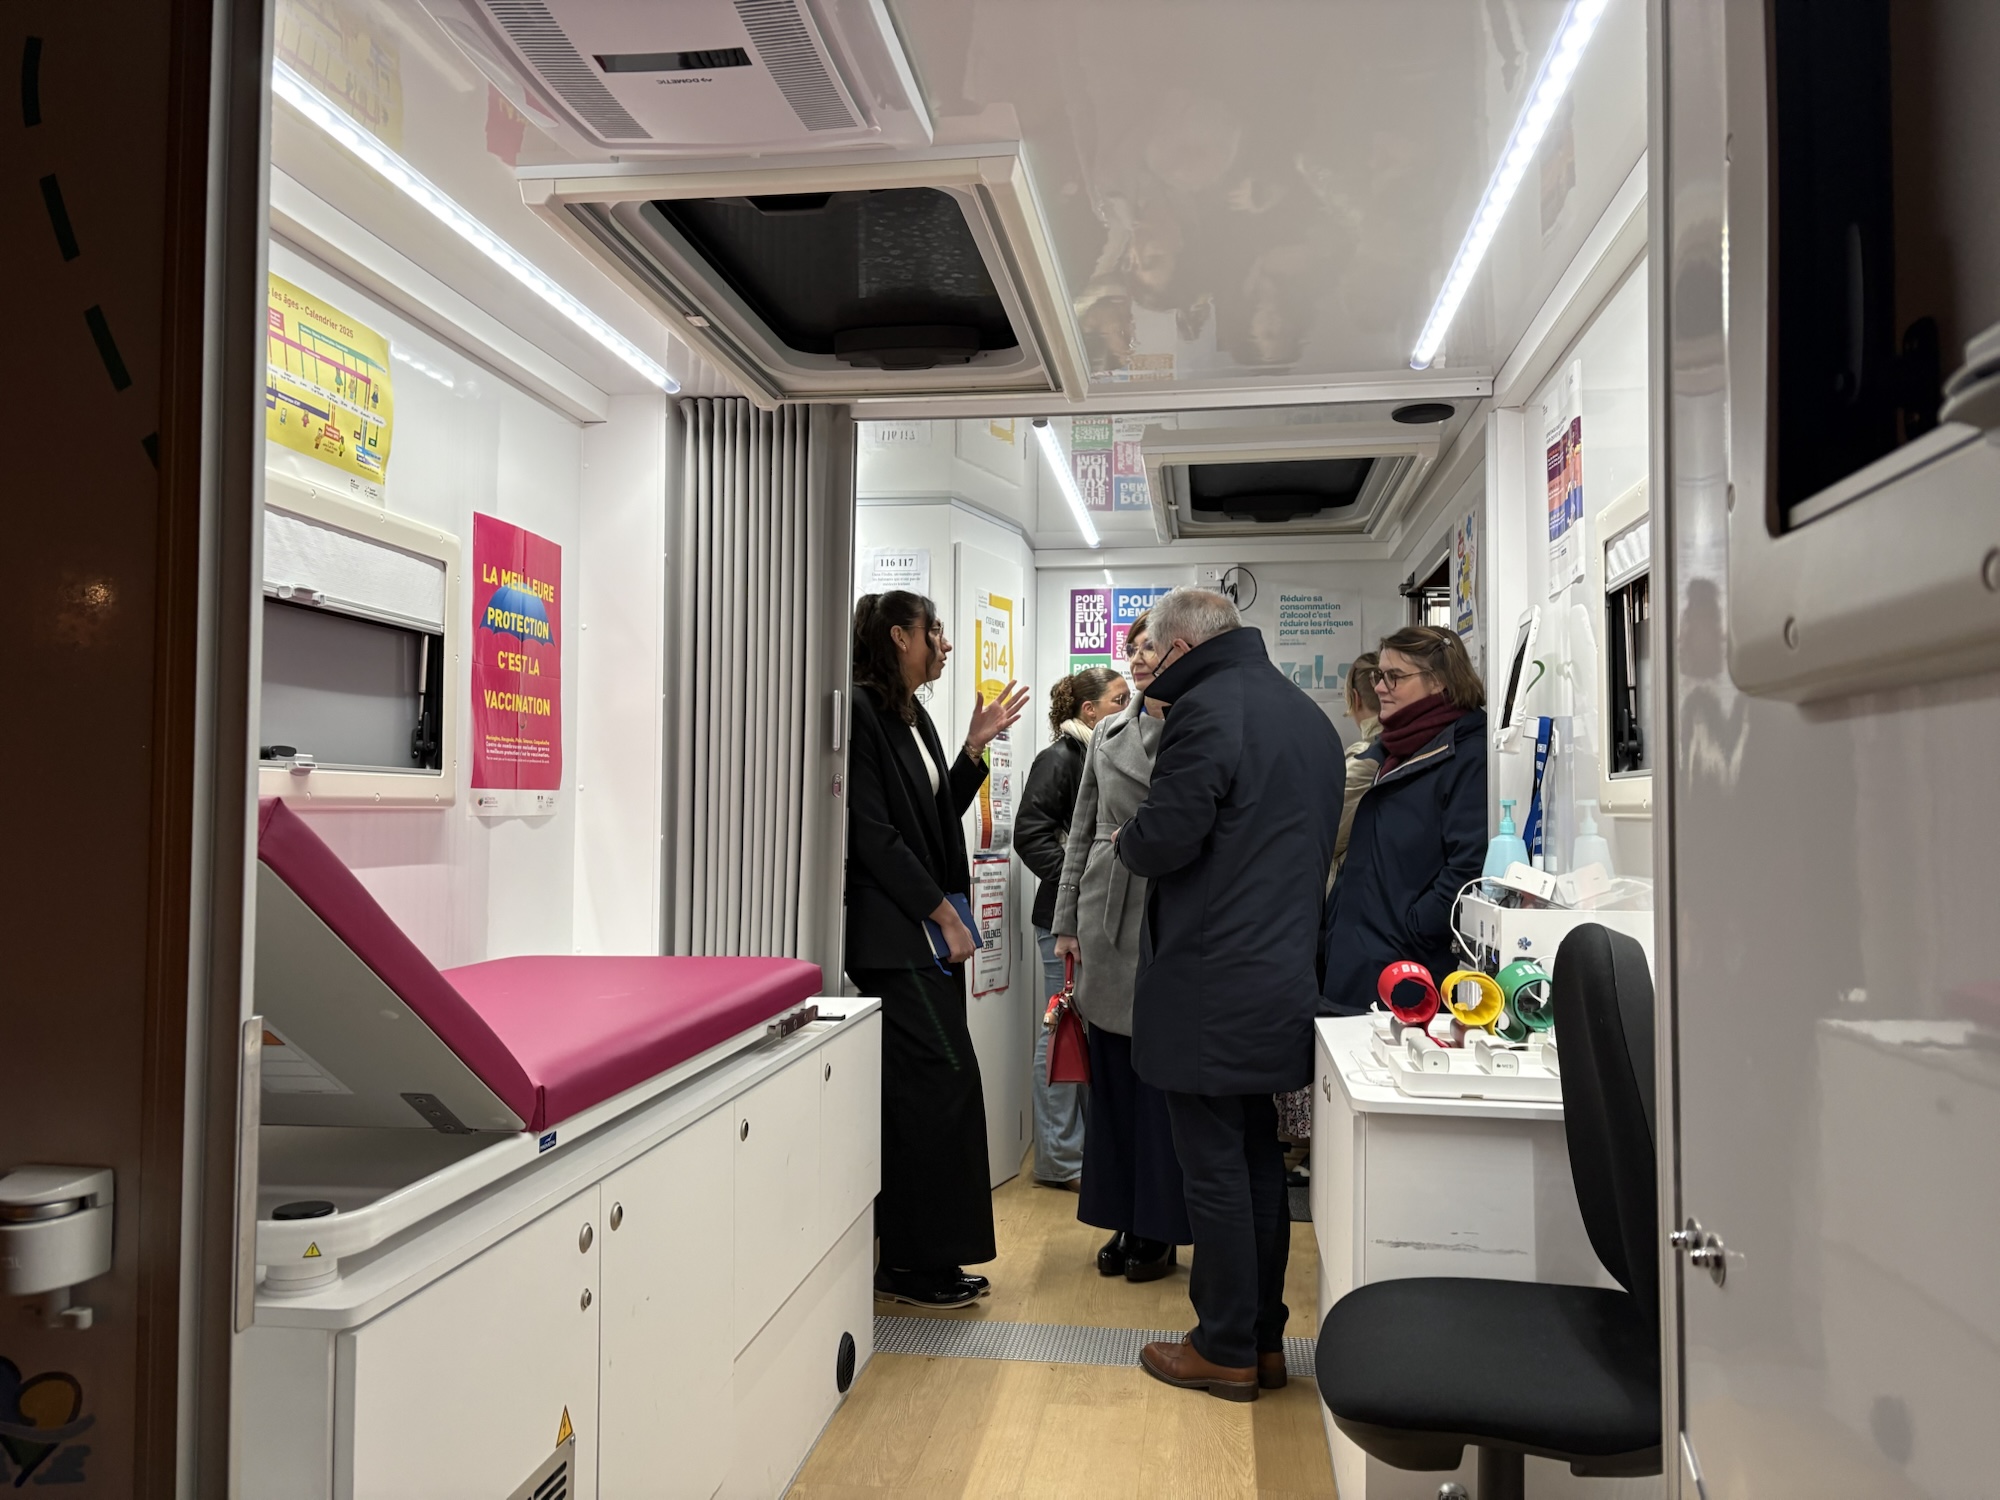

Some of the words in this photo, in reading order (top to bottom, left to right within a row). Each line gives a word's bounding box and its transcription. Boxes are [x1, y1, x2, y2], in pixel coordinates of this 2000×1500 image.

[271, 287, 282, 301] les
[283, 293, 299, 310] âges
[304, 306, 338, 330] Calendrier
[339, 324, 354, 339] 2025
[881, 558, 896, 567] 116
[898, 558, 914, 567] 117
[483, 563, 498, 586] LA
[501, 568, 555, 603] MEILLEURE
[1075, 594, 1104, 603] POUR
[1280, 594, 1312, 602] Réduire
[1075, 602, 1108, 614] ELLE,
[1075, 611, 1108, 624] EUX,
[1280, 611, 1311, 619] d'alcool
[1312, 611, 1331, 619] c'est
[487, 606, 549, 640] PROTECTION
[1280, 619, 1309, 627] réduire
[1310, 619, 1322, 627] les
[1323, 619, 1354, 628] risques
[1075, 622, 1108, 638] LUI,
[1280, 628, 1299, 636] pour
[1311, 627, 1335, 635] santé.
[1075, 637, 1104, 649] MOI
[1116, 630, 1124, 659] POUR
[983, 639, 1007, 674] 3114
[498, 650, 527, 673] C'EST
[528, 656, 540, 677] LA
[484, 689, 551, 717] VACCINATION
